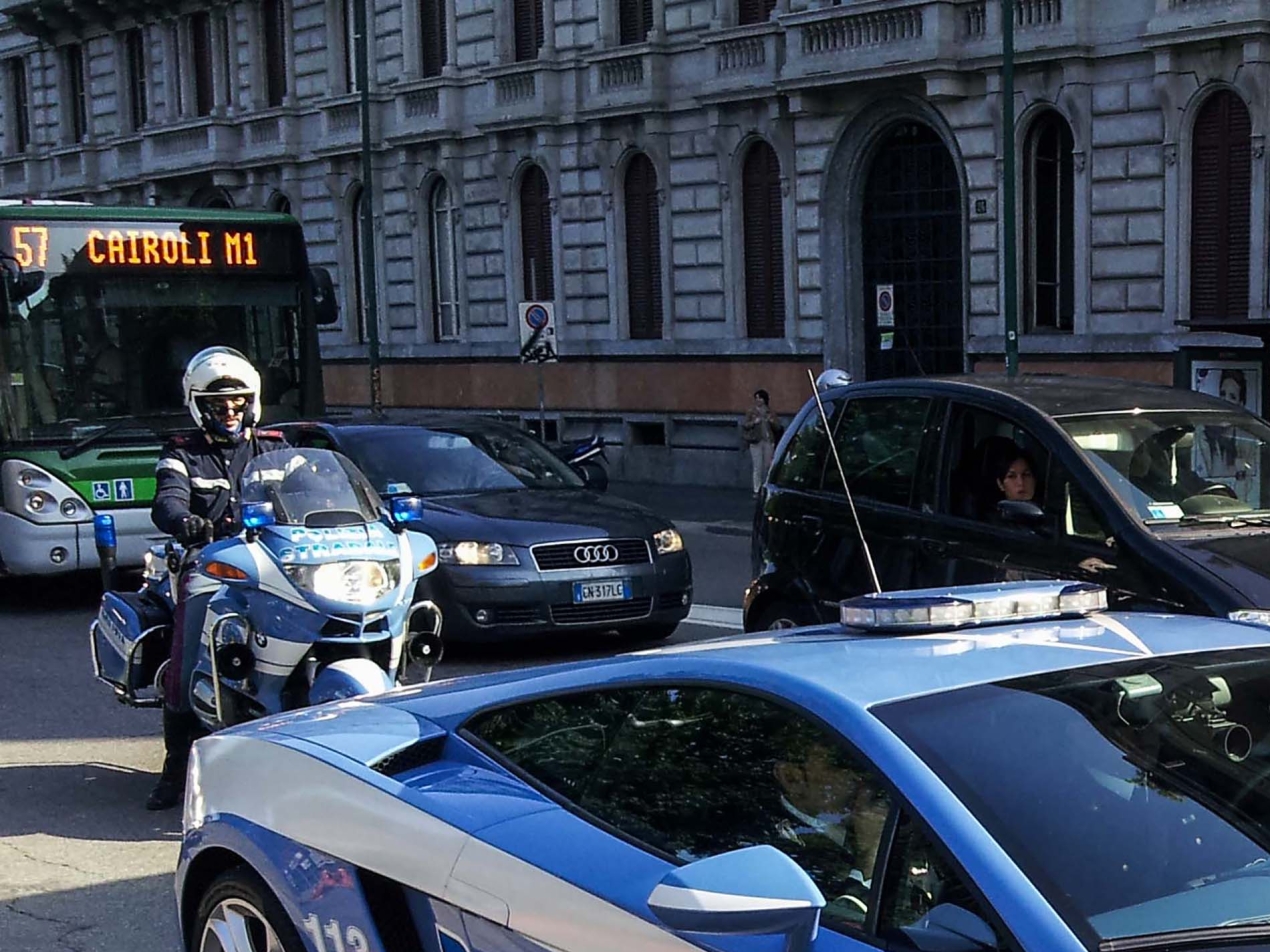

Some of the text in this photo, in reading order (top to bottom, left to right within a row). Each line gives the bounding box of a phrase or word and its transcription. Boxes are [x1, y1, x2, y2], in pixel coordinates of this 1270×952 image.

[12, 225, 257, 267] 57 CAIROLI M1
